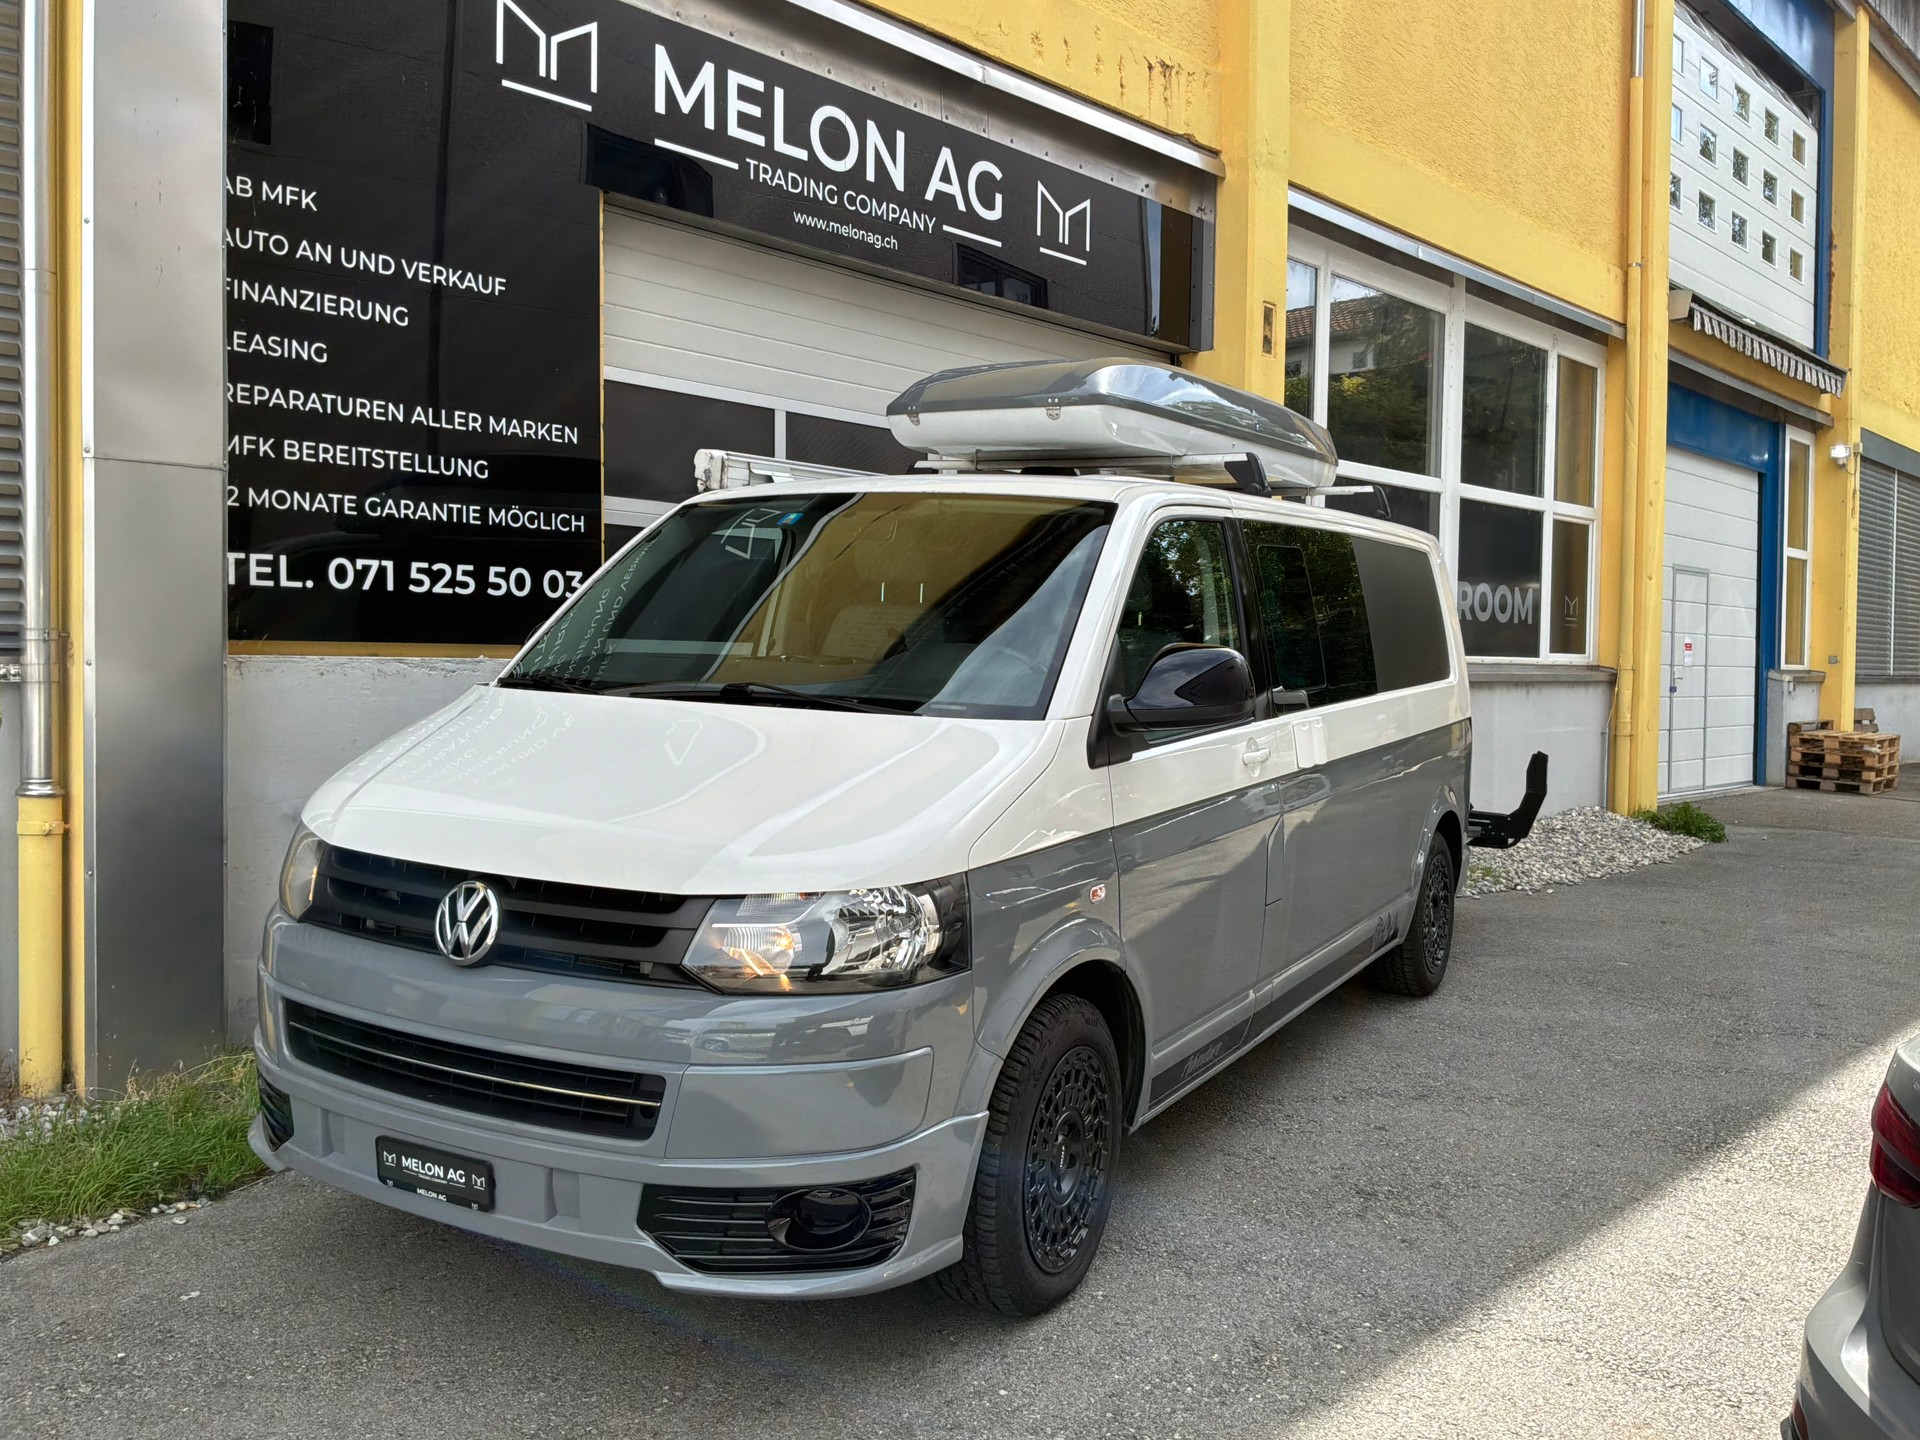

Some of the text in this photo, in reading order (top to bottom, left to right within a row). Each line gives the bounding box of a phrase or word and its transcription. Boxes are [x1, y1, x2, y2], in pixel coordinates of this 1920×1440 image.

[654, 43, 1004, 221] MELON AG
[262, 180, 318, 212] MFK
[745, 157, 937, 235] TRADING COMPANY
[793, 211, 899, 251] www.melonag.ch
[295, 239, 332, 265] AN
[340, 246, 396, 276] UND
[400, 258, 507, 297] VERKAUF
[227, 330, 328, 364] EASING
[410, 405, 482, 433] ALLER
[489, 415, 578, 445] MARKEN
[283, 439, 489, 479] BEREITSTELLUNG
[248, 487, 358, 516] MONATE
[364, 496, 482, 525] GARANTIE
[488, 505, 585, 533] MÖGLICH
[227, 551, 583, 600] TEL. 071 525 50 03
[1457, 580, 1534, 625] ROOM
[401, 1155, 444, 1179] MELON
[446, 1167, 466, 1183] AG
[416, 1187, 447, 1202] MELON AG
